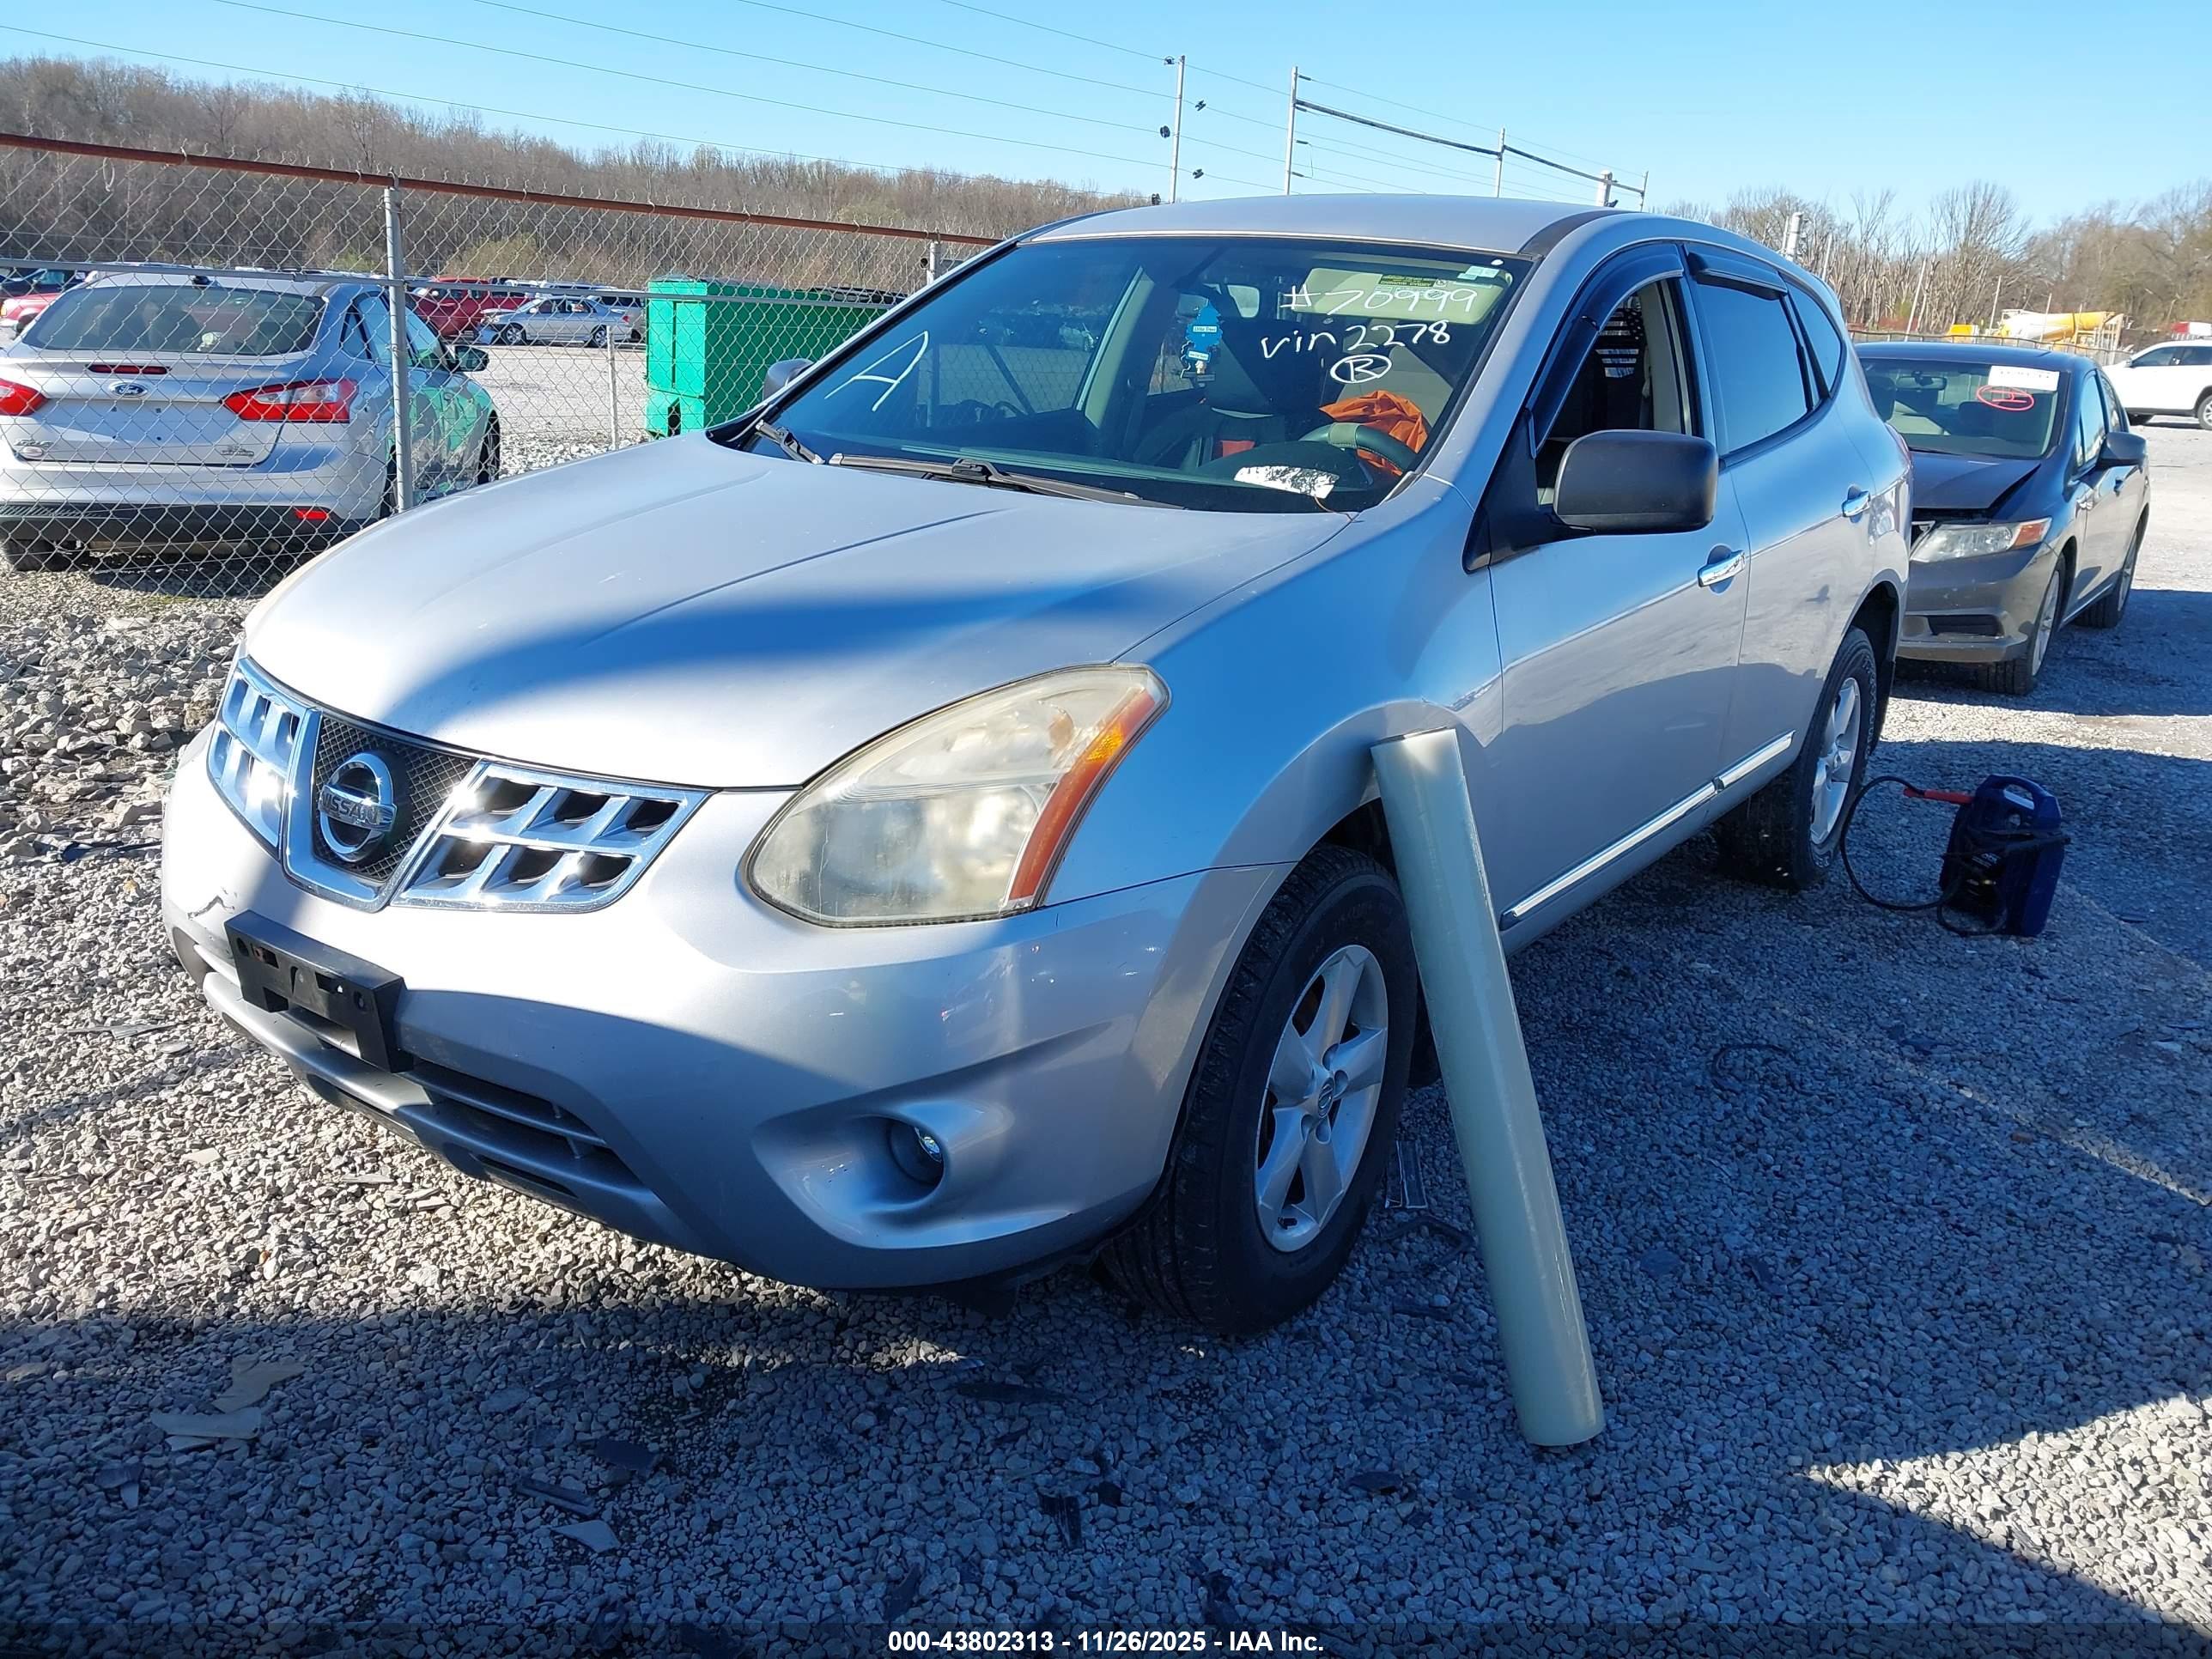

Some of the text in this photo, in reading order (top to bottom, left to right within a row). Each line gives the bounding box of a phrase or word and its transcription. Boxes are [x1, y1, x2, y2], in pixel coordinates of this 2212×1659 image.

[1279, 283, 1478, 315] #70999
[1345, 319, 1451, 351] 2278
[823, 329, 929, 412] A
[320, 791, 379, 825] NISSAN
